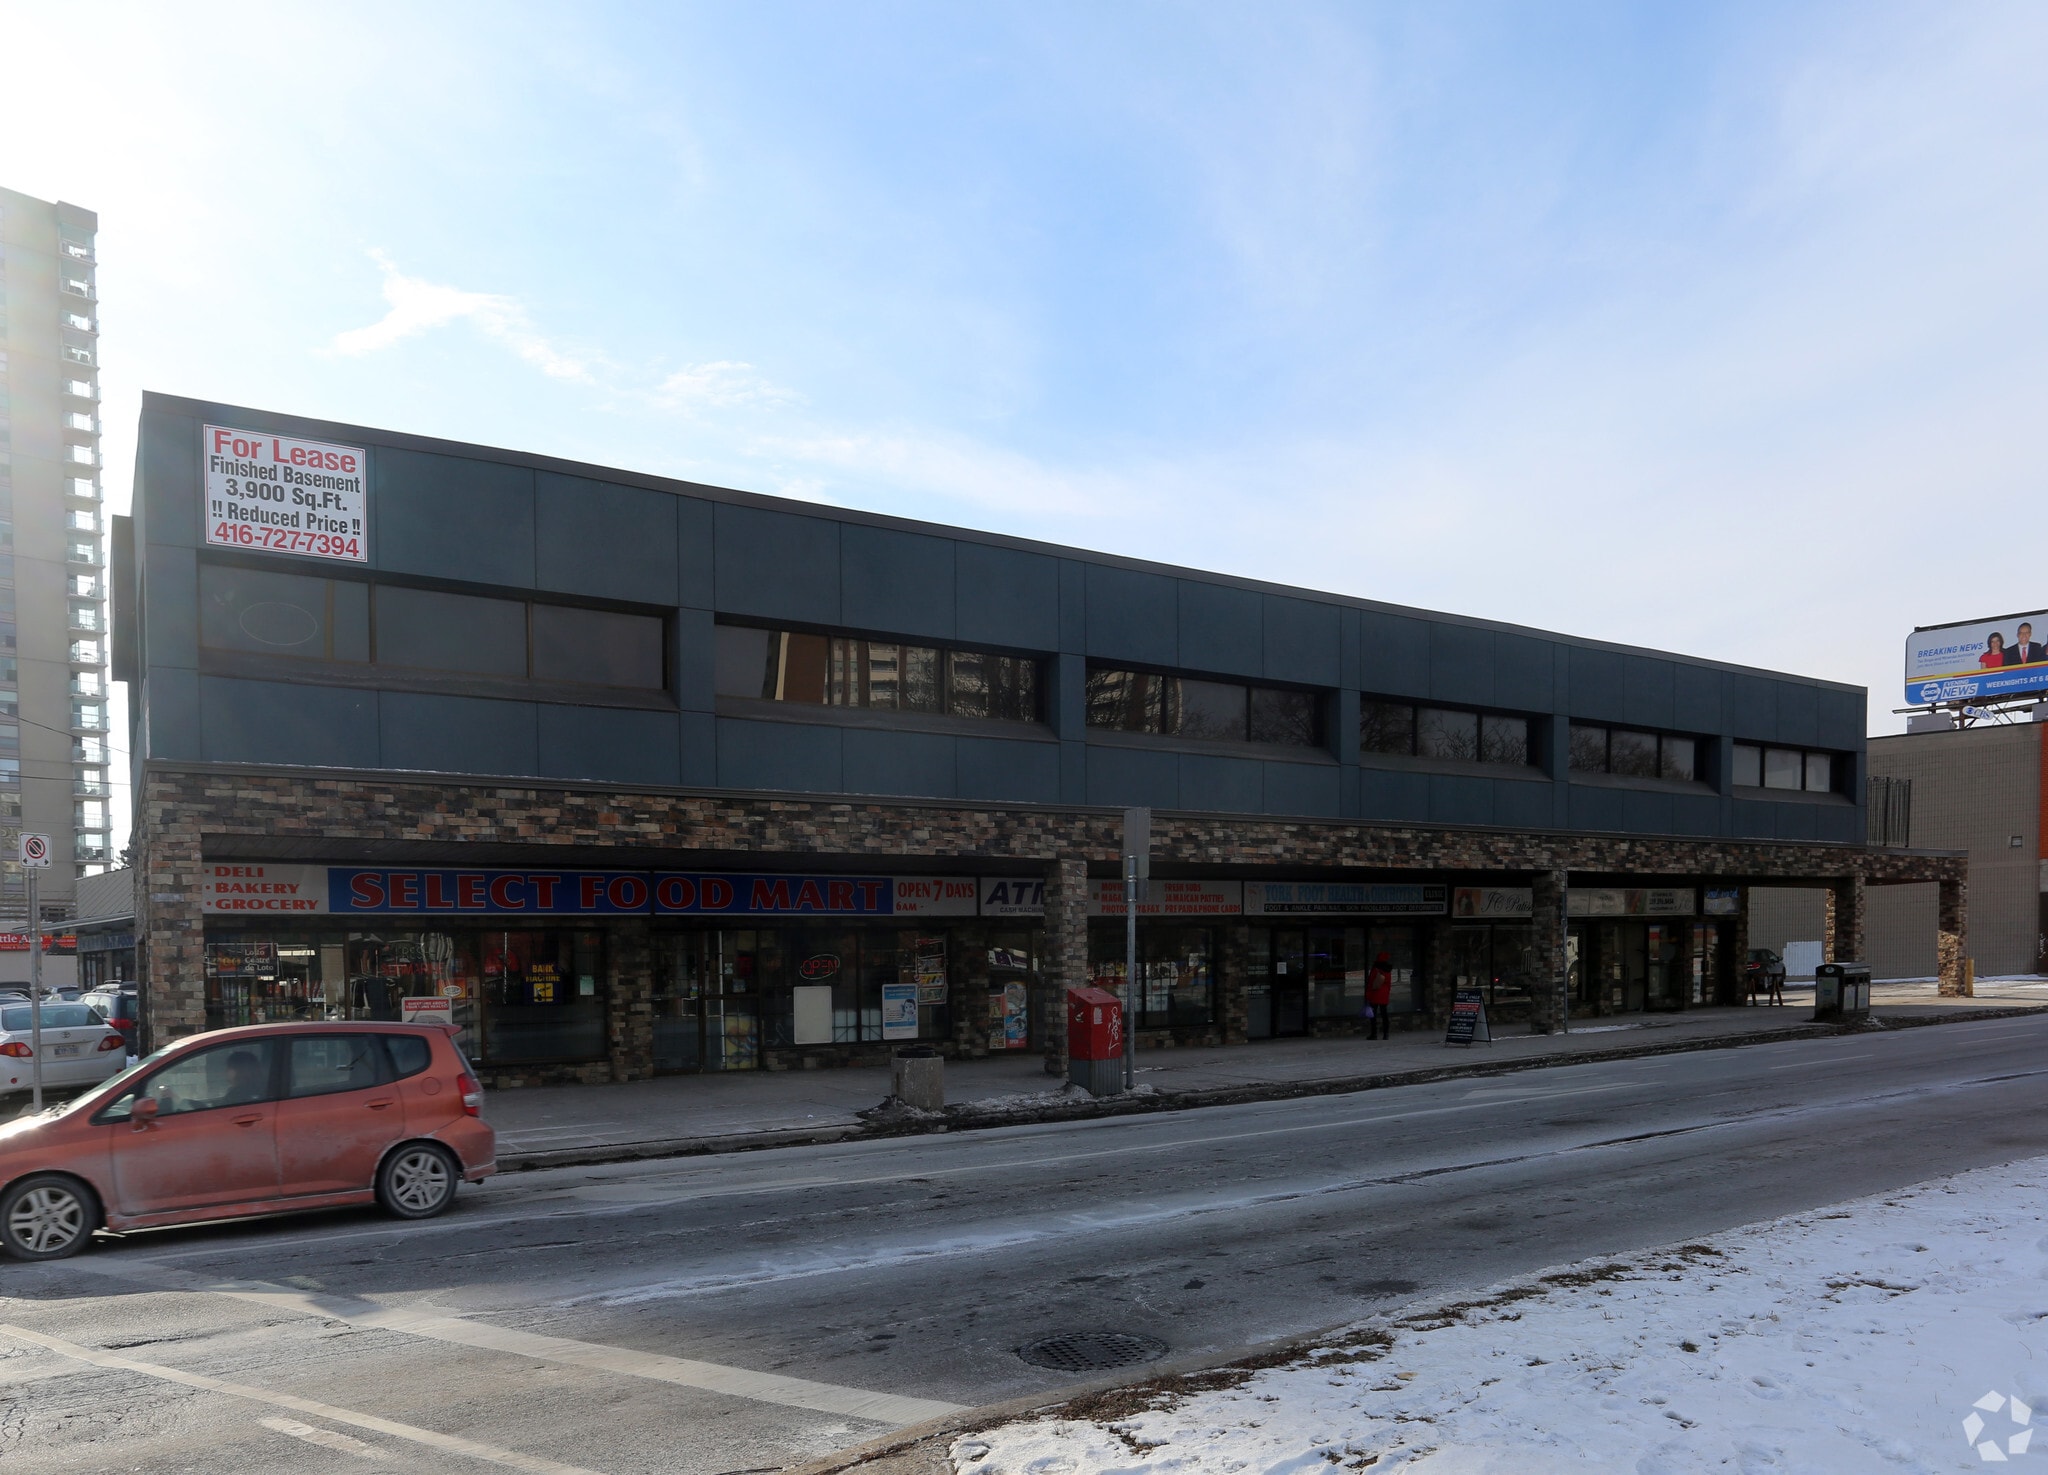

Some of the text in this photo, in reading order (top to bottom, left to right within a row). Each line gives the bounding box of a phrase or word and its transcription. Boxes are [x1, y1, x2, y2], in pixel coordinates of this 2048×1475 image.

[214, 429, 356, 473] For Lease
[210, 455, 361, 493] Finished Basement
[225, 478, 348, 511] 3,900 Sq.Ft.
[228, 502, 300, 528] Reduced
[306, 512, 348, 534] Price
[214, 521, 359, 557] 416-727-7394
[1917, 645, 1958, 658] BREAKING
[1959, 642, 1984, 652] NEWS
[1986, 677, 2028, 689] WEEKNIGHTS
[2029, 676, 2038, 684] AT
[1943, 685, 1977, 698] NEWS
[215, 866, 264, 878] DELI
[215, 882, 300, 894] BAKERY
[350, 872, 884, 911] SELECT FOOD MART
[897, 879, 975, 902] OPEN 7 DAYS
[1264, 885, 1292, 902] YORK
[1297, 885, 1324, 902] FOOT
[215, 898, 319, 910] GROCERY
[1165, 893, 1225, 902] JAMAICAN PATTIES
[1265, 904, 1281, 912] FOOT
[532, 964, 555, 973] BANK
[802, 959, 839, 975] OPEN
